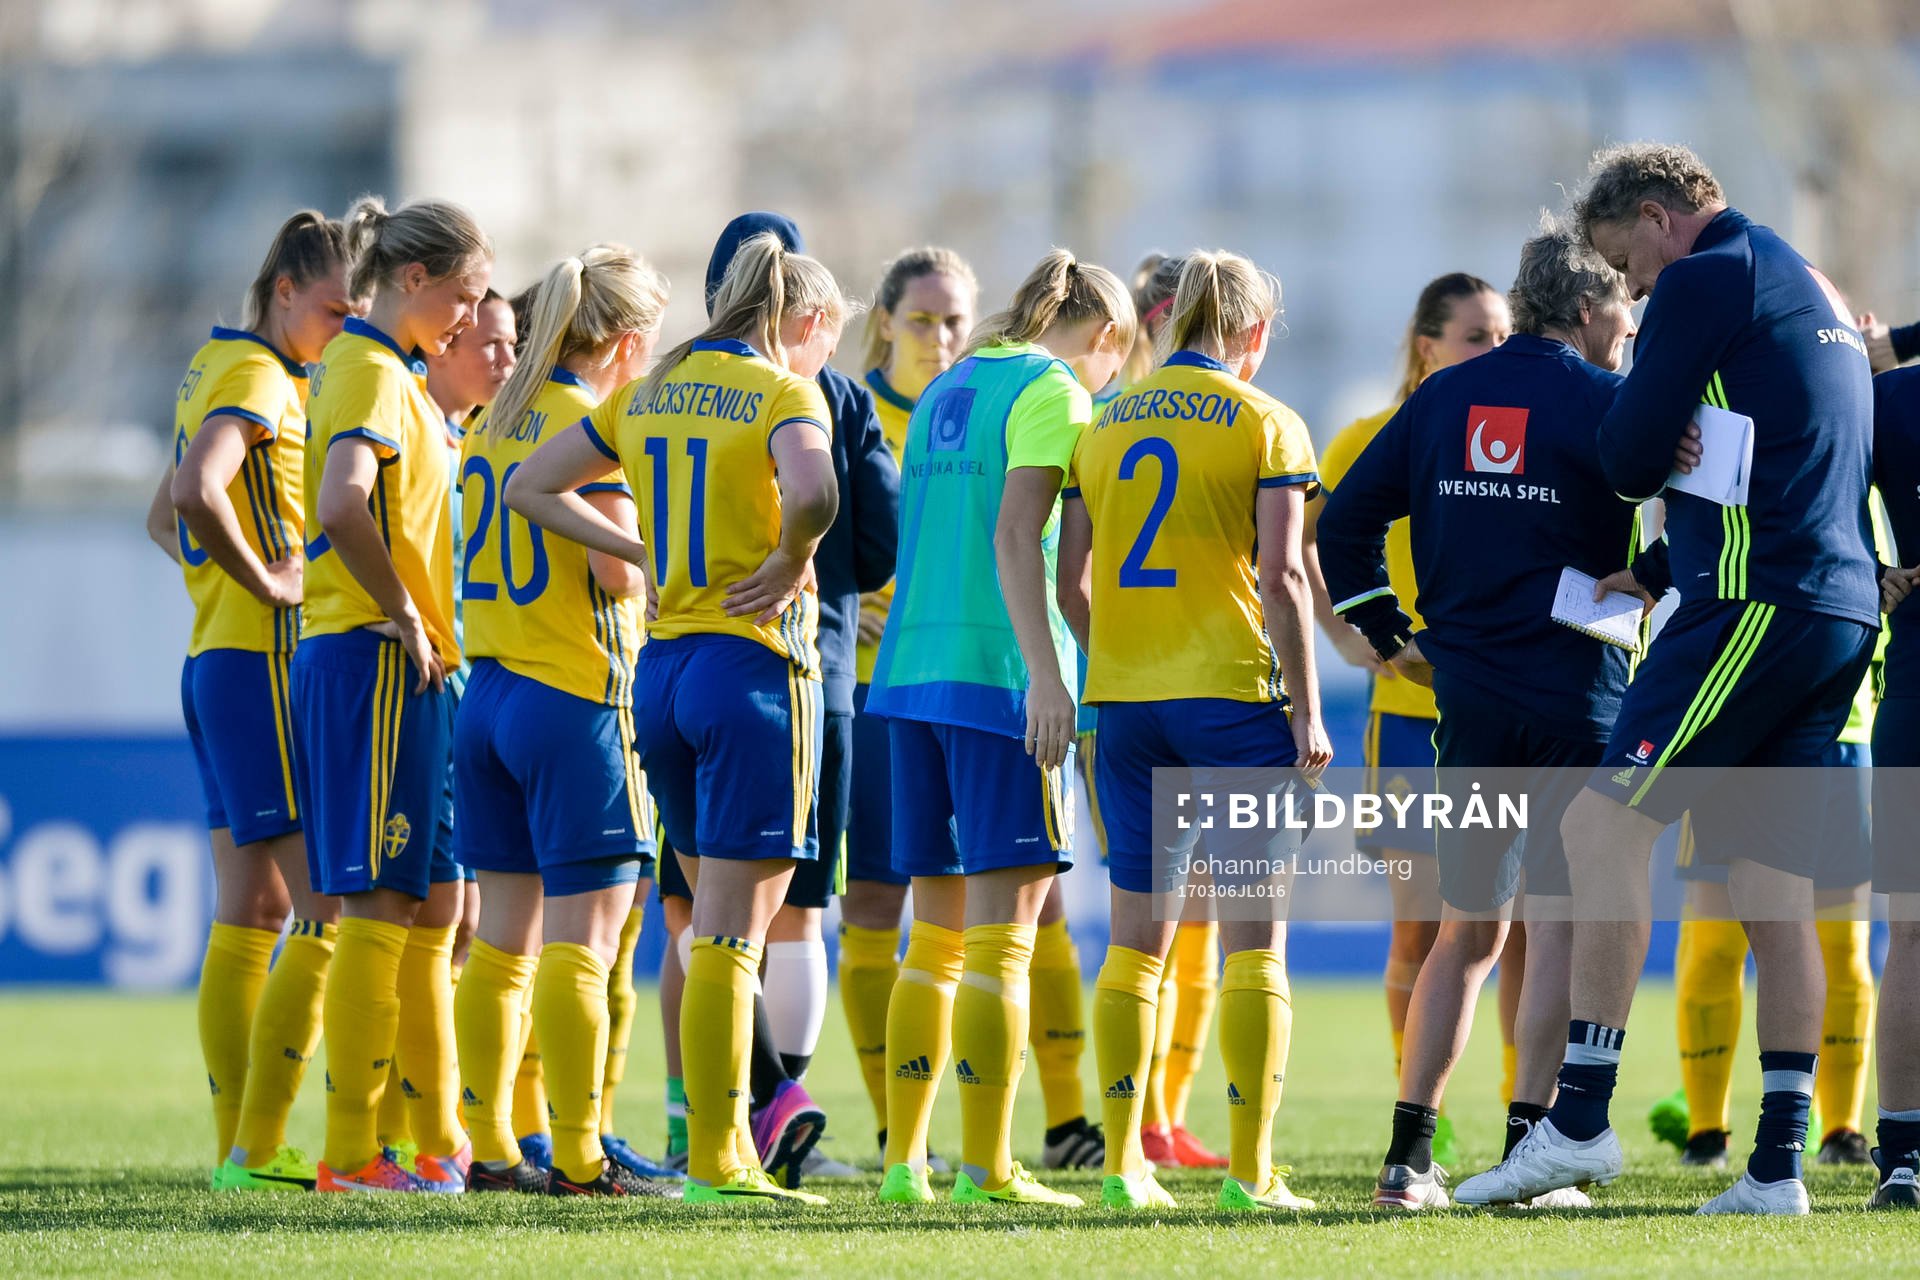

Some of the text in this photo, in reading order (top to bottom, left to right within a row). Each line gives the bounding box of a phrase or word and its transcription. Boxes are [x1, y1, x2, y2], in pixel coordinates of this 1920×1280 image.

[1093, 389, 1242, 433] ANDERSSON
[462, 455, 549, 606] 20
[644, 437, 708, 587] 11
[1118, 437, 1179, 588] 2
[1438, 480, 1561, 504] SVENSKA SPEL
